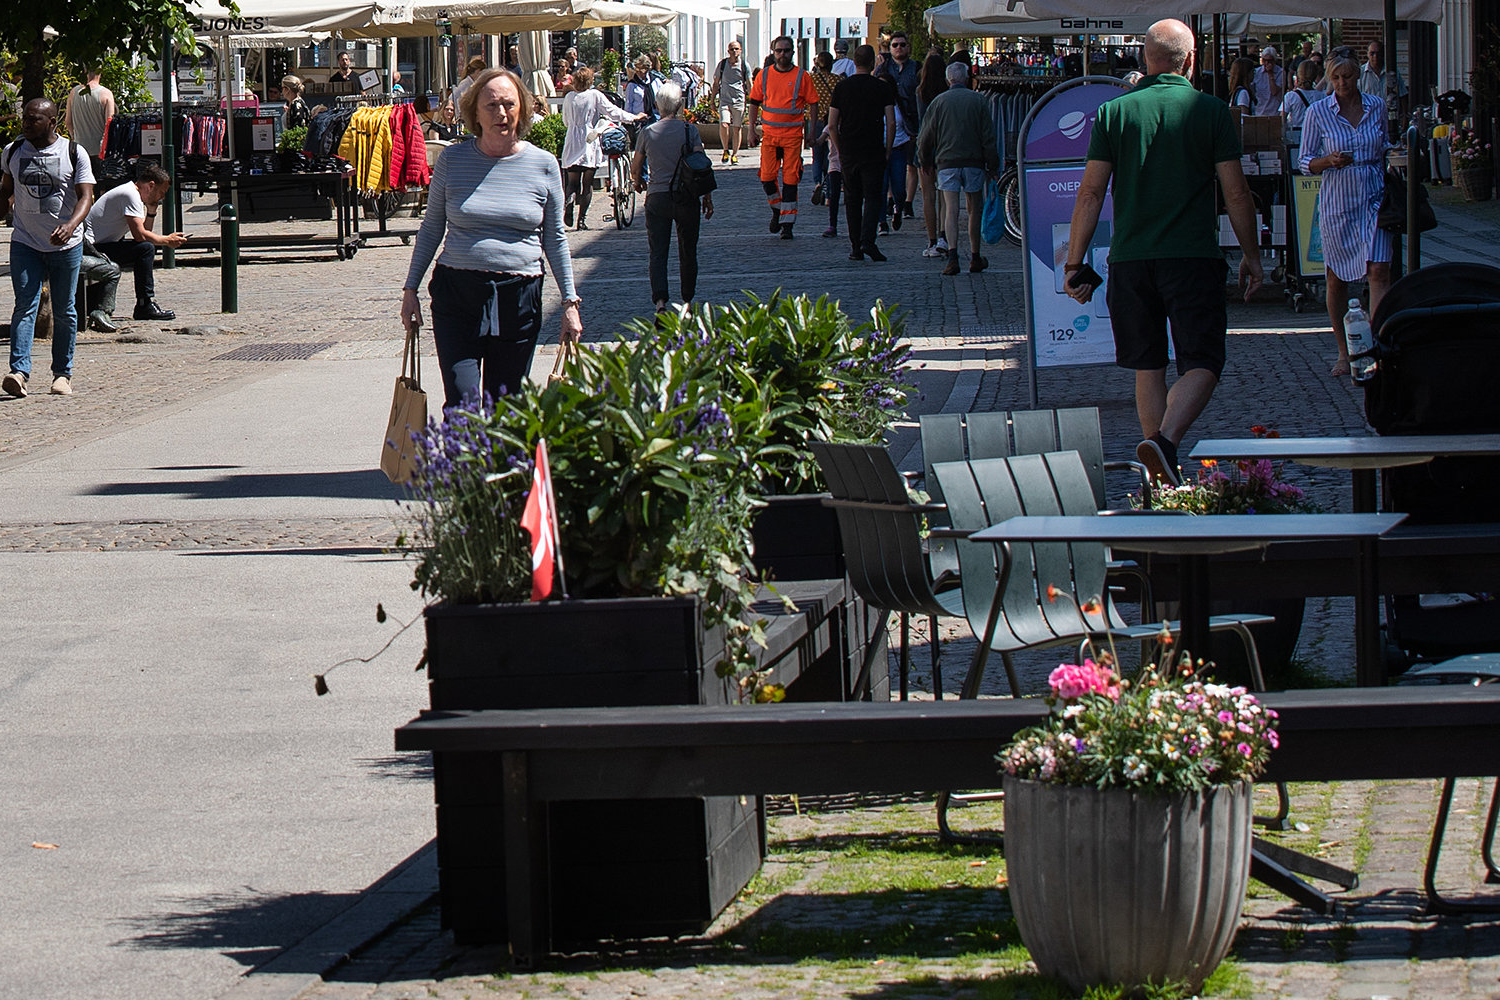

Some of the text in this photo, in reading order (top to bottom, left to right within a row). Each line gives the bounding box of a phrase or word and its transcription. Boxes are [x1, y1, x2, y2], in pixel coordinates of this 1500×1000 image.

[203, 16, 265, 32] JONES
[1060, 18, 1125, 29] bahne
[1048, 181, 1082, 193] ONEP
[1049, 329, 1075, 341] 129
